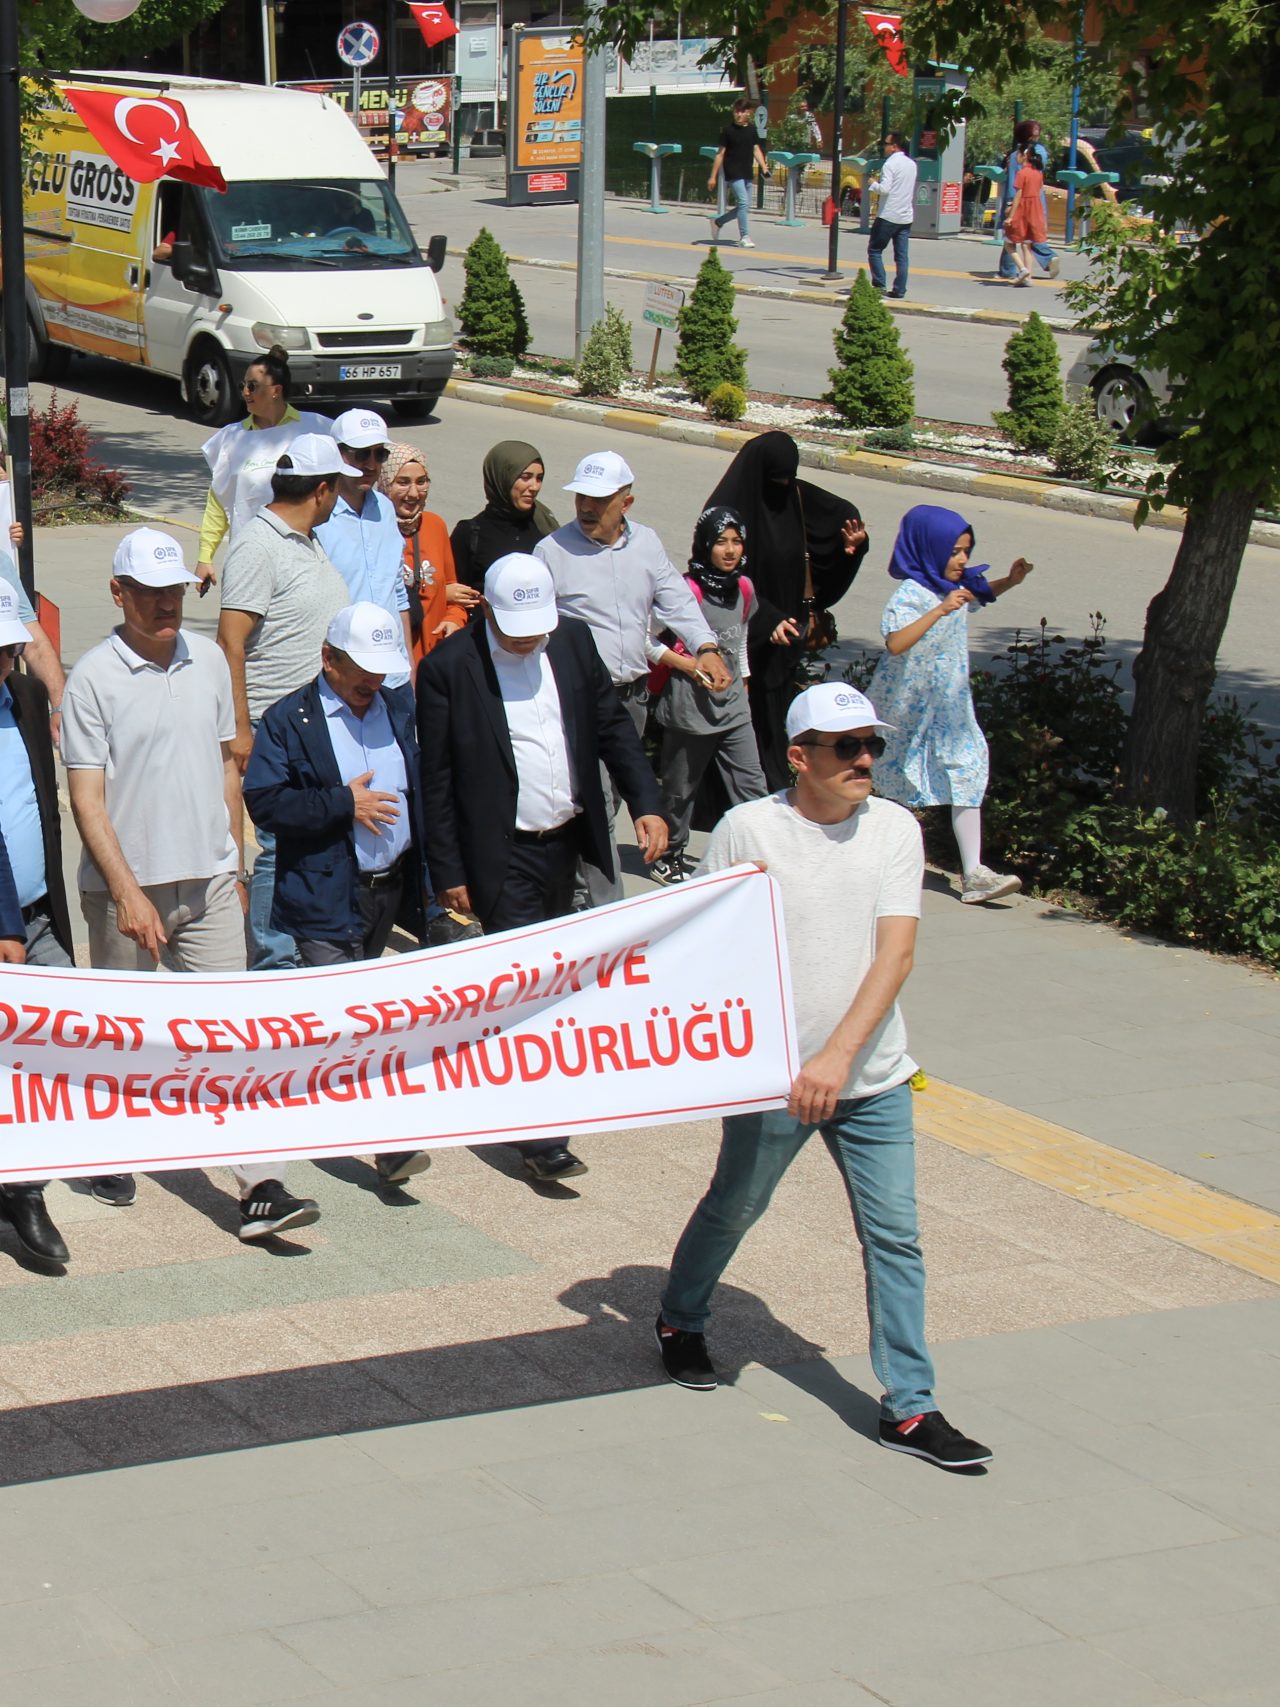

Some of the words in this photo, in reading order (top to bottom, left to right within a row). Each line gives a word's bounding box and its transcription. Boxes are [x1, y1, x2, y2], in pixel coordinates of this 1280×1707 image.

[70, 160, 135, 206] GROSS
[345, 368, 358, 378] 66
[362, 367, 376, 377] HP
[379, 366, 399, 377] 657
[167, 1012, 342, 1062] ÇEVRE,
[345, 952, 593, 1048] ŞEHİRCİLİK
[597, 940, 650, 988] VE
[85, 1048, 372, 1125] DEĞİŞİKLİĞİ
[381, 1045, 426, 1097] İL
[431, 998, 755, 1092] MÜDÜRLÜĞÜ
